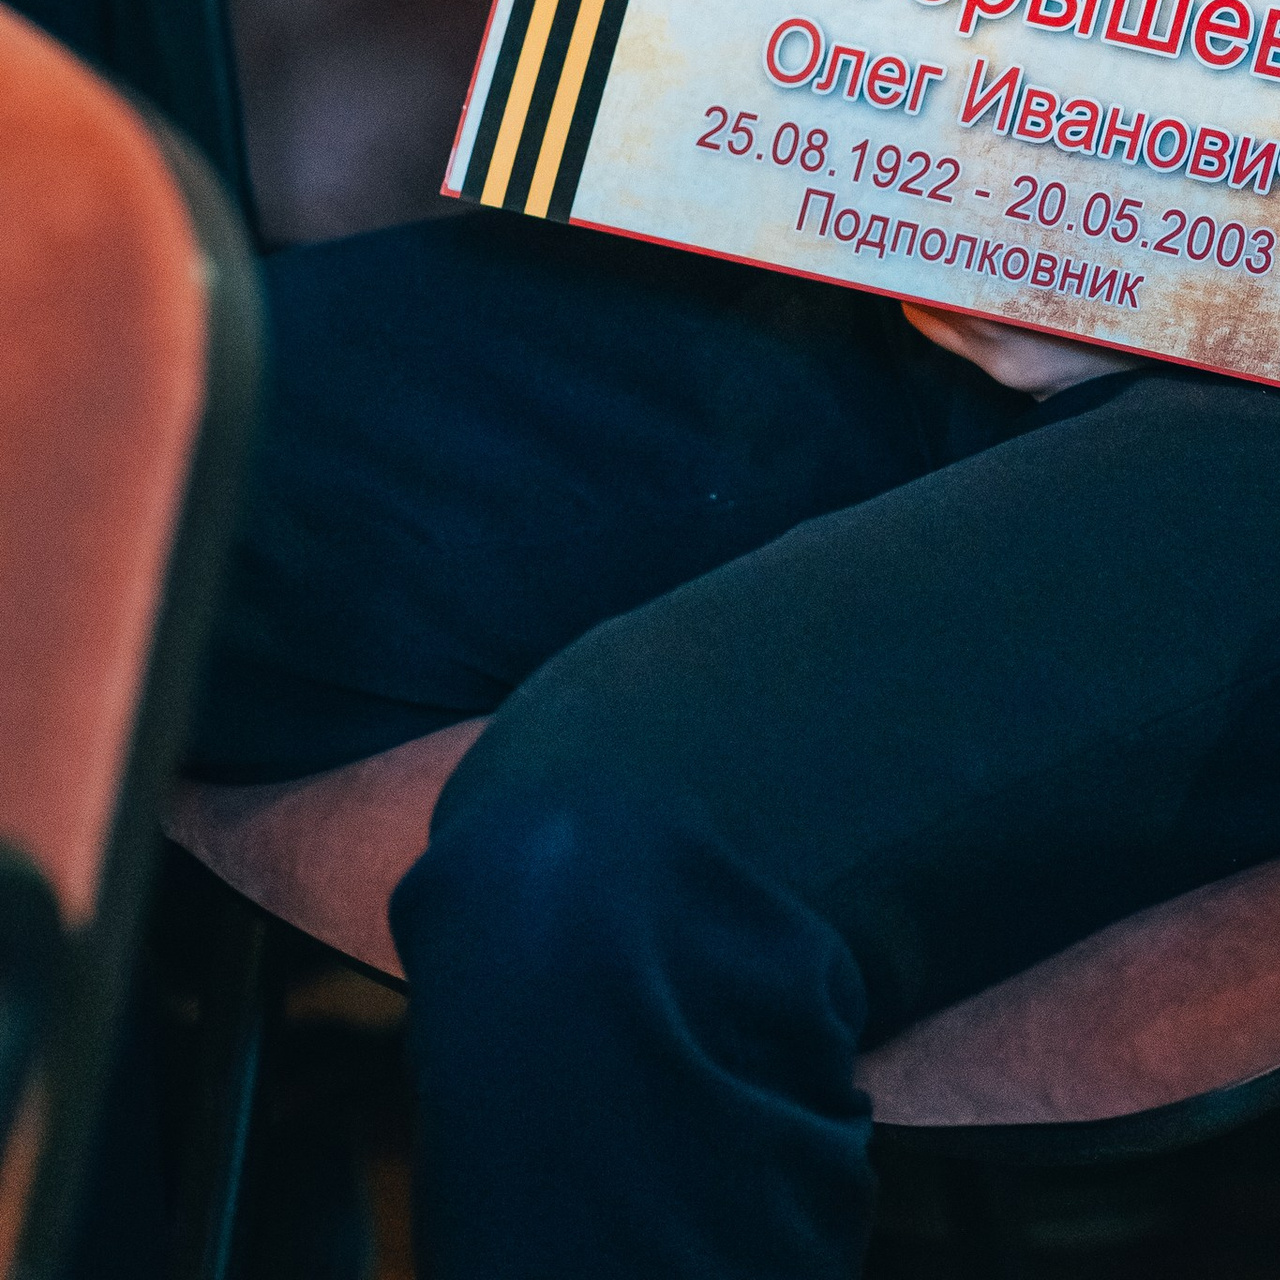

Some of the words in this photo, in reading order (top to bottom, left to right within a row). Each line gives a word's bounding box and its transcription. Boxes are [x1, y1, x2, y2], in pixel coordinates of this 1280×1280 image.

[765, 17, 945, 115] Олег
[696, 106, 961, 203] 25.08.1922
[1004, 175, 1275, 276] 20.05.2003
[796, 188, 1146, 310] Подполковник
